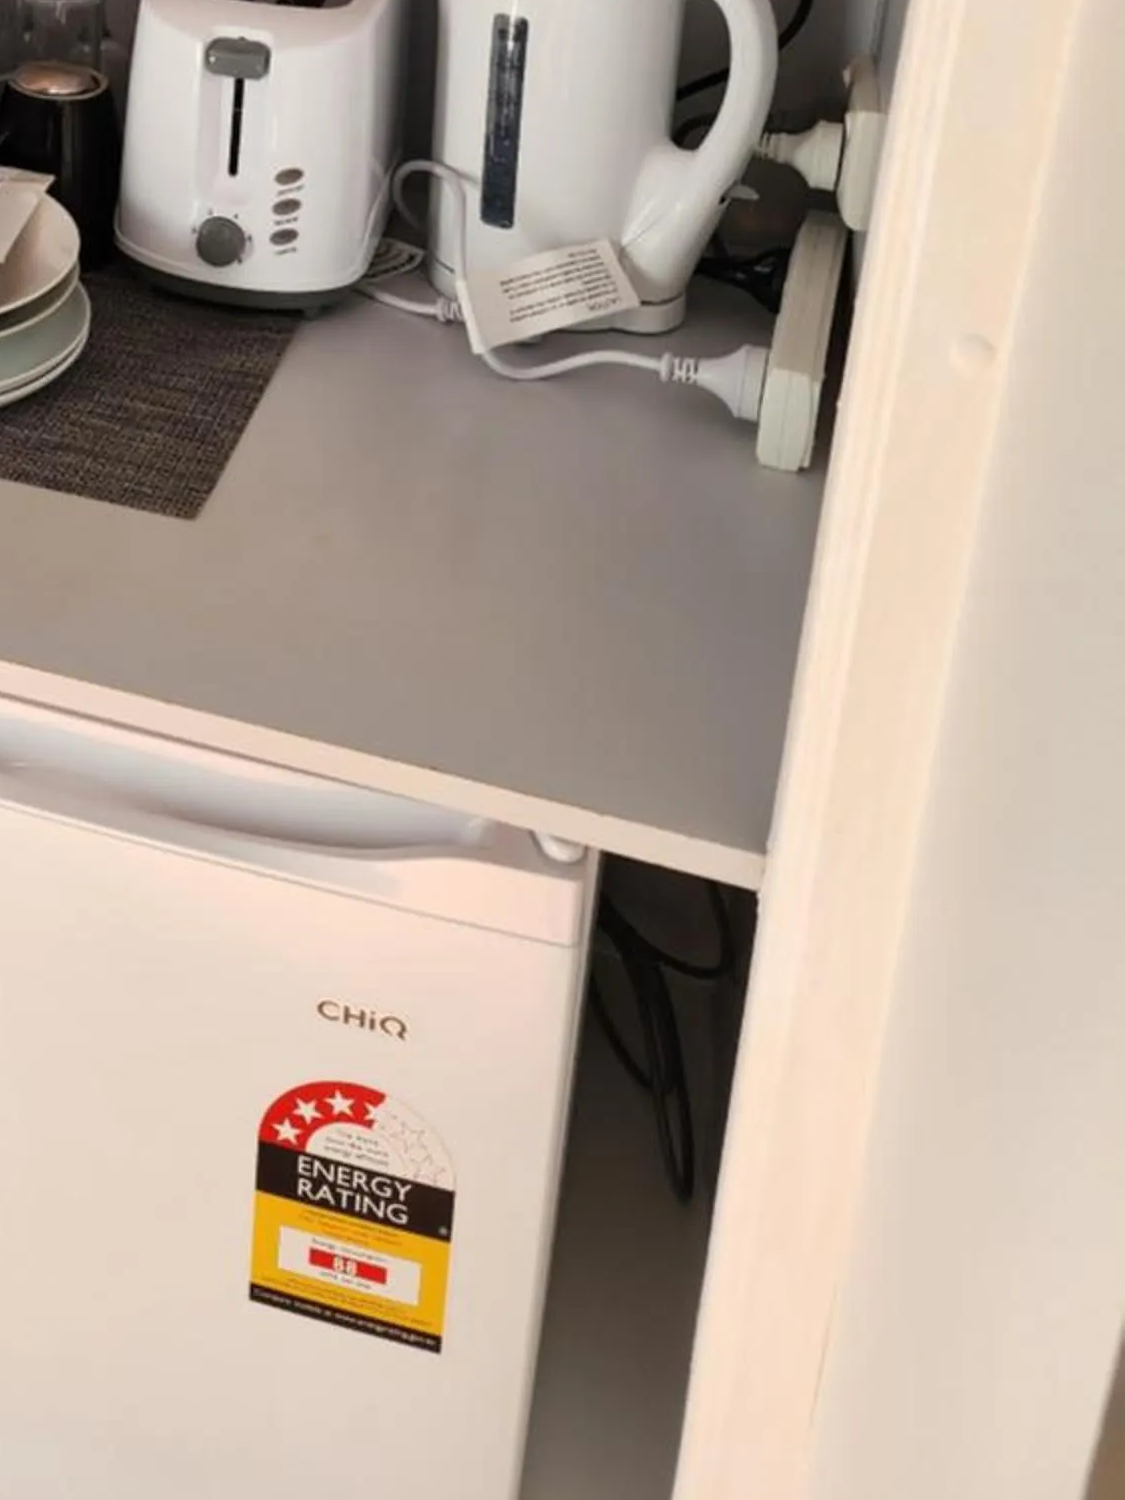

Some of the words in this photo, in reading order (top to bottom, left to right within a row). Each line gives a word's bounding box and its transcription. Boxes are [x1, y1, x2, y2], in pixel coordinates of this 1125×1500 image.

[316, 999, 409, 1041] CHiQ
[296, 1155, 412, 1202] ENERGY
[296, 1179, 409, 1226] RATING
